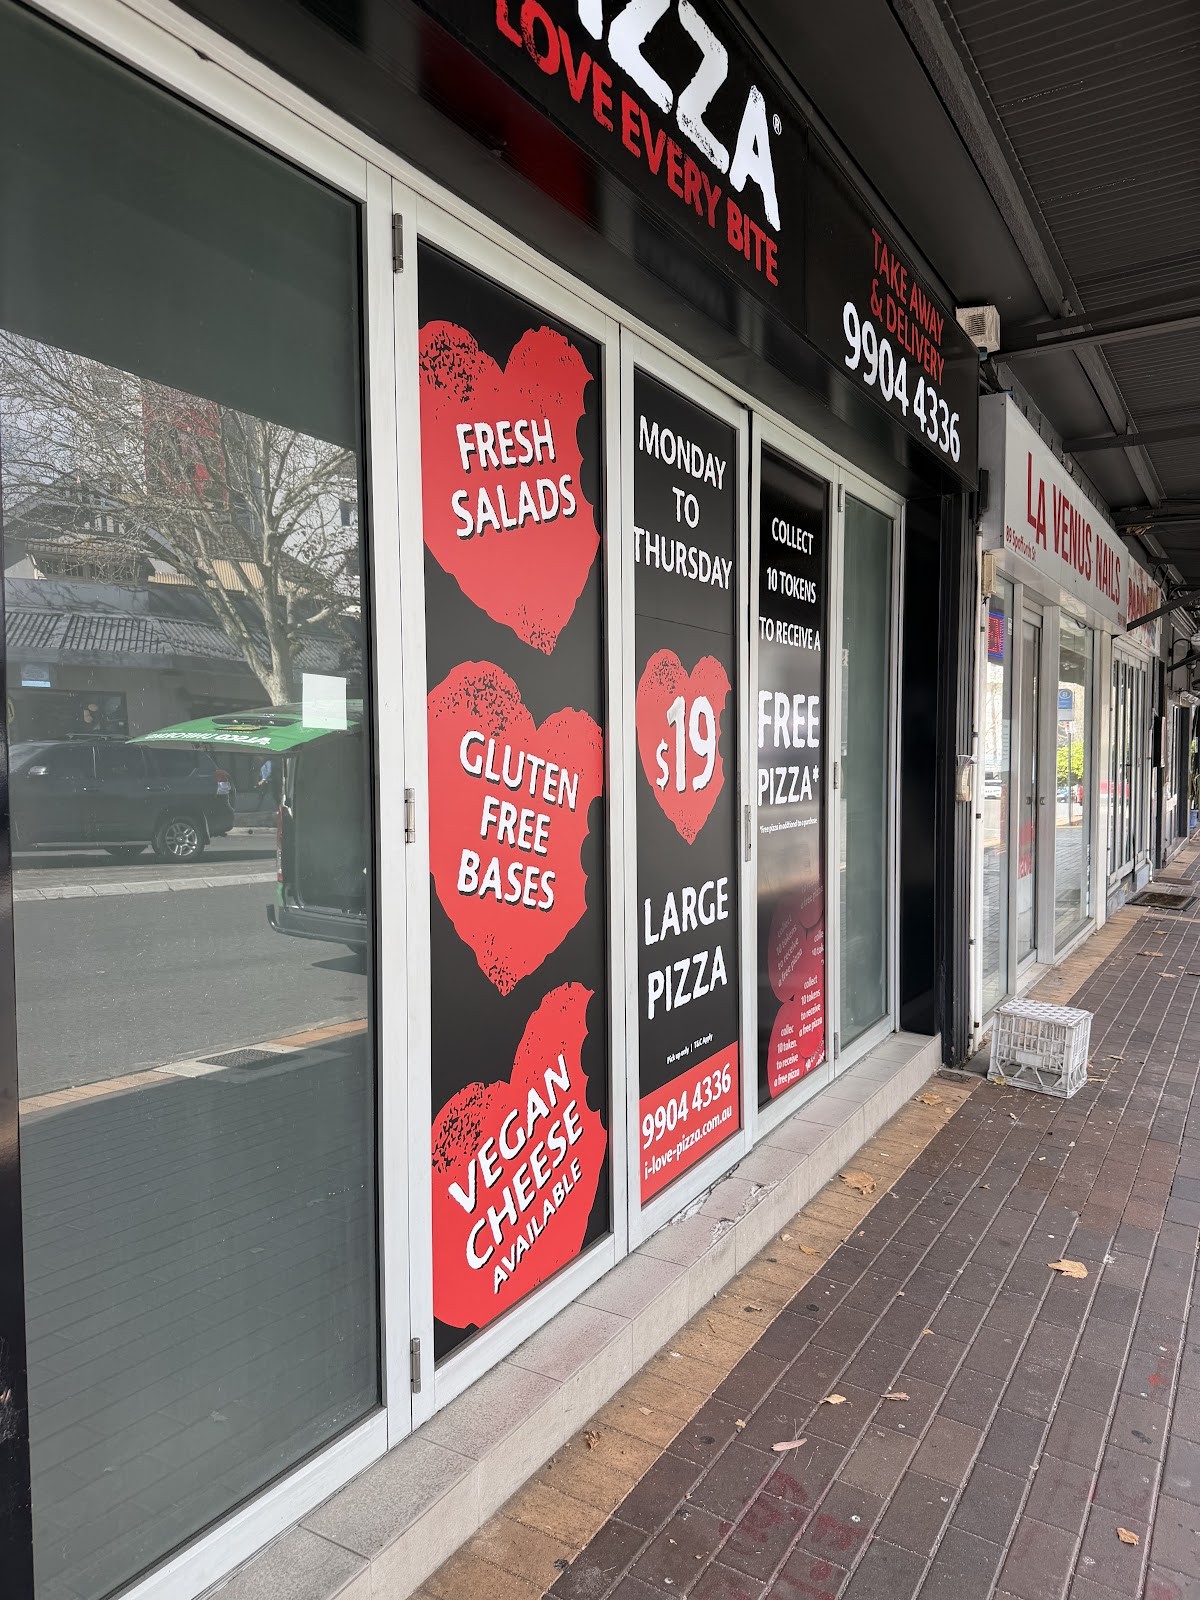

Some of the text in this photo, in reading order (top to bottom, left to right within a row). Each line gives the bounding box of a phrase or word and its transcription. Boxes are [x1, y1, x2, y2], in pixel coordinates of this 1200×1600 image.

[496, 0, 778, 287] LOVE EVERY BITE
[576, 0, 781, 231] ZZA
[872, 228, 944, 346] TAKE AWAY
[870, 279, 944, 386] & DELIVERY
[843, 301, 960, 463] 9904 4336
[456, 419, 556, 473] FRESH
[639, 414, 726, 490] MONDAY
[452, 474, 577, 540] SALADS
[672, 486, 700, 528] TO
[771, 516, 813, 555] COLLECT
[1027, 451, 1047, 551] LA
[1053, 483, 1092, 582] VENUS
[1096, 534, 1121, 606] NAILS
[634, 526, 732, 590] THURSDAY
[766, 566, 816, 604] 10 TOKENS
[759, 616, 820, 651] TO RECEIVE A
[656, 695, 716, 793] $19
[758, 690, 819, 749] FREE
[460, 730, 579, 811] GLUTEN
[480, 795, 550, 857] FREE
[457, 848, 555, 912] BASES
[644, 876, 728, 945] LARGE
[648, 945, 727, 1020] PIZZA
[801, 989, 821, 1005] 10 tokens
[804, 975, 817, 989] collect
[806, 1003, 821, 1018] receive
[667, 1053, 675, 1064] Pick
[675, 1052, 681, 1061] up
[681, 1046, 690, 1055] only
[703, 1032, 713, 1044] Apply
[777, 1043, 783, 1054] 10
[803, 1024, 812, 1035] free
[812, 1017, 823, 1032] pizza
[777, 1053, 799, 1070] to receive
[778, 1074, 788, 1085] free
[788, 1069, 800, 1084] pizza
[448, 1054, 573, 1214] VEGAN
[642, 1062, 731, 1151] 9904 4336
[644, 1103, 732, 1181] i-love-pizza.com.au
[465, 1100, 583, 1270] CHEESE
[493, 1157, 583, 1294] AVAILABLE
